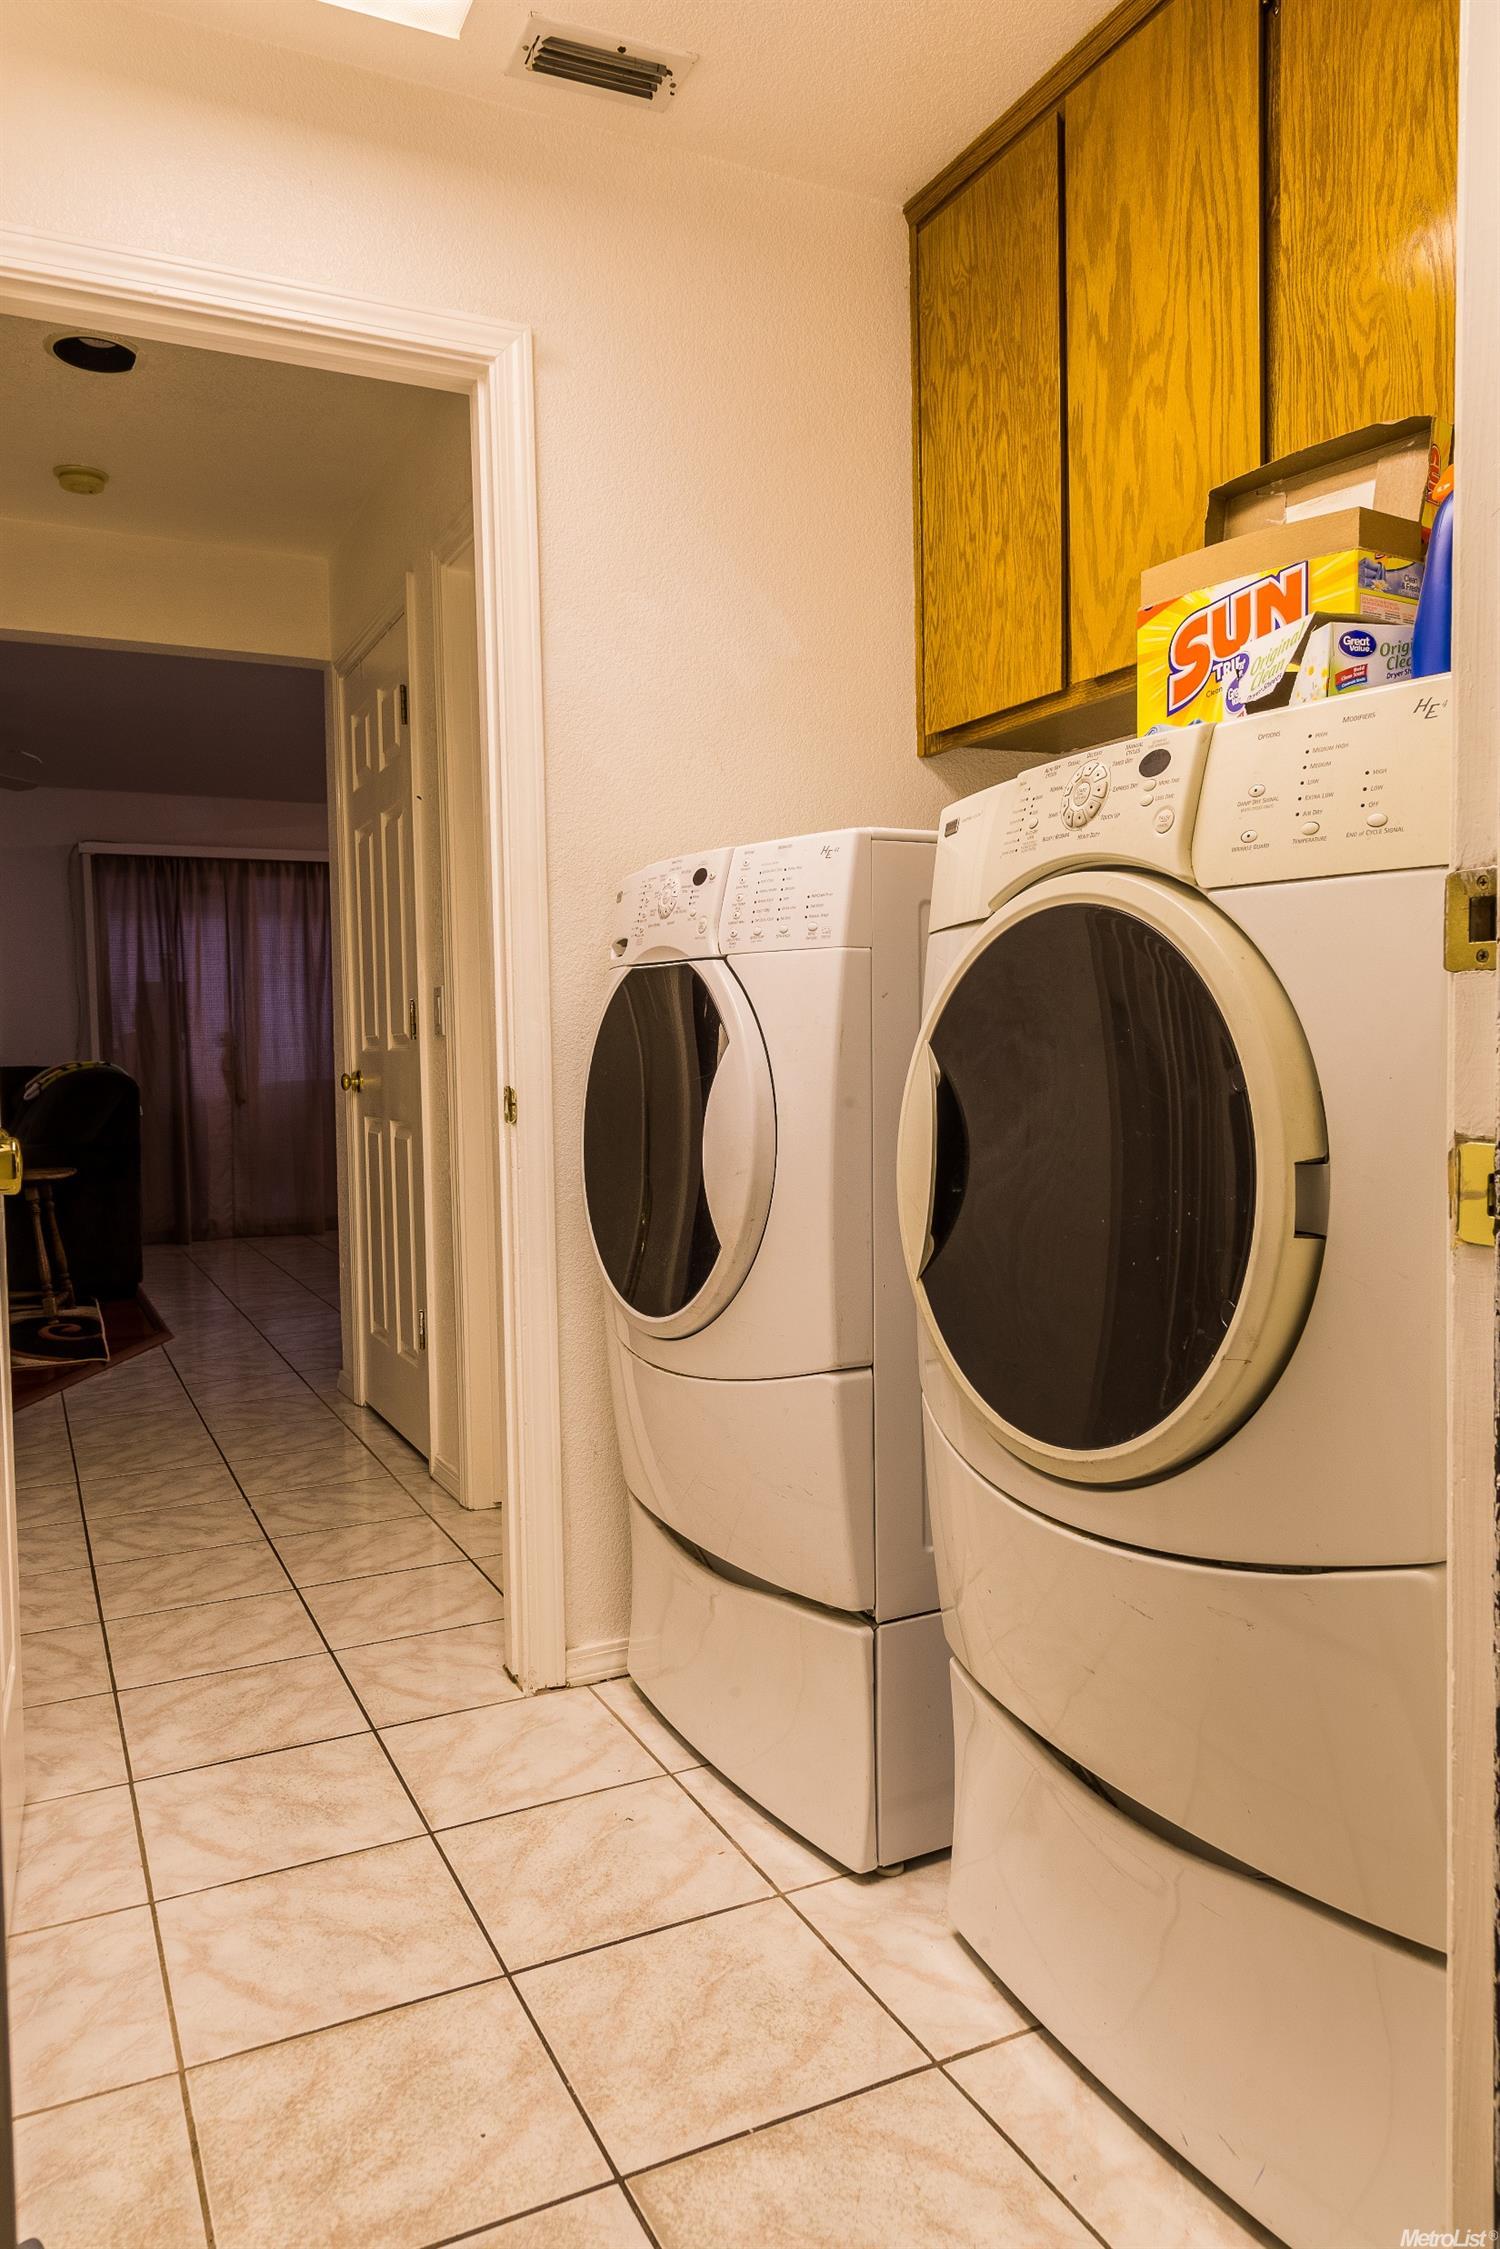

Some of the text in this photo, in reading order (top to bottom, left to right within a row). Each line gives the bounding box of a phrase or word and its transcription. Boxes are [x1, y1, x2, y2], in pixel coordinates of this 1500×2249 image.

[1167, 561, 1309, 717] SUN
[1250, 621, 1305, 675] Original
[1343, 635, 1370, 647] Great
[1381, 638, 1413, 656] Origi
[1251, 658, 1285, 691] Clean
